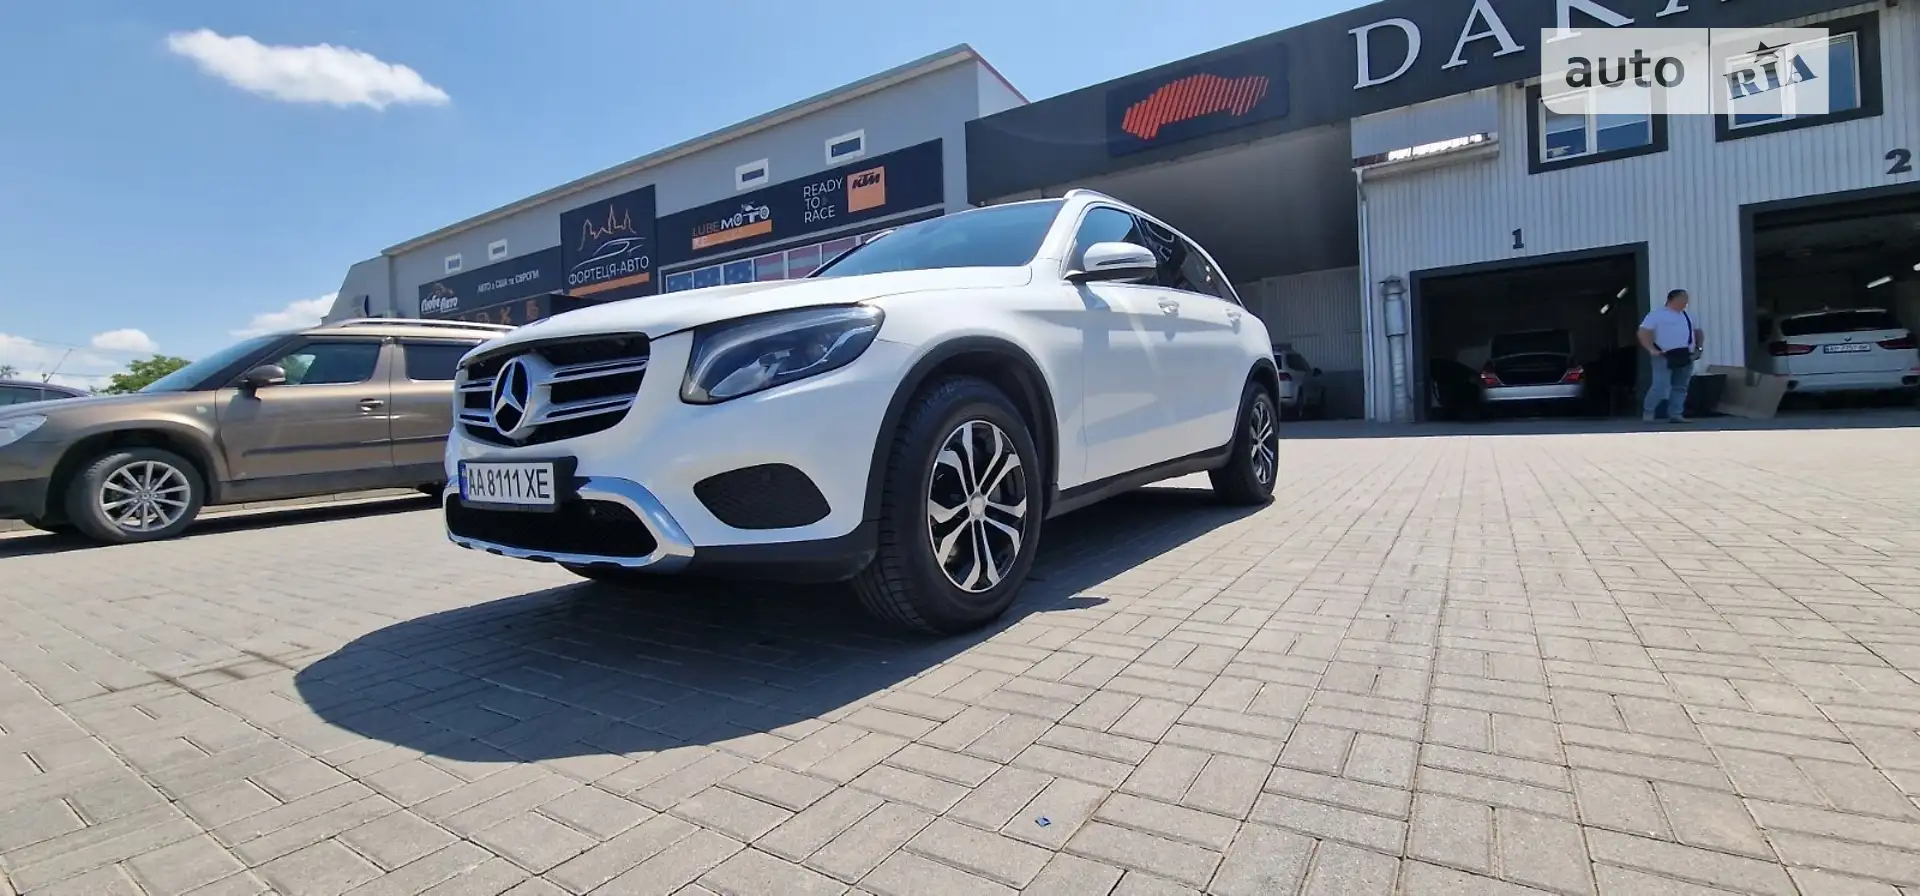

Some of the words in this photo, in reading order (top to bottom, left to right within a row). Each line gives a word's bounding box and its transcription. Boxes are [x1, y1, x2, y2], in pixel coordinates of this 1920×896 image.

[1885, 148, 1912, 174] 2
[803, 177, 842, 198] READY
[852, 171, 880, 189] KTM
[804, 196, 820, 211] TO
[804, 204, 836, 224] RACE
[1512, 228, 1524, 249] 1
[568, 255, 649, 285] ФОРТЕЦЯ-АВТО
[468, 468, 486, 496] AA
[487, 469, 521, 498] 8111
[523, 468, 550, 499] XE
